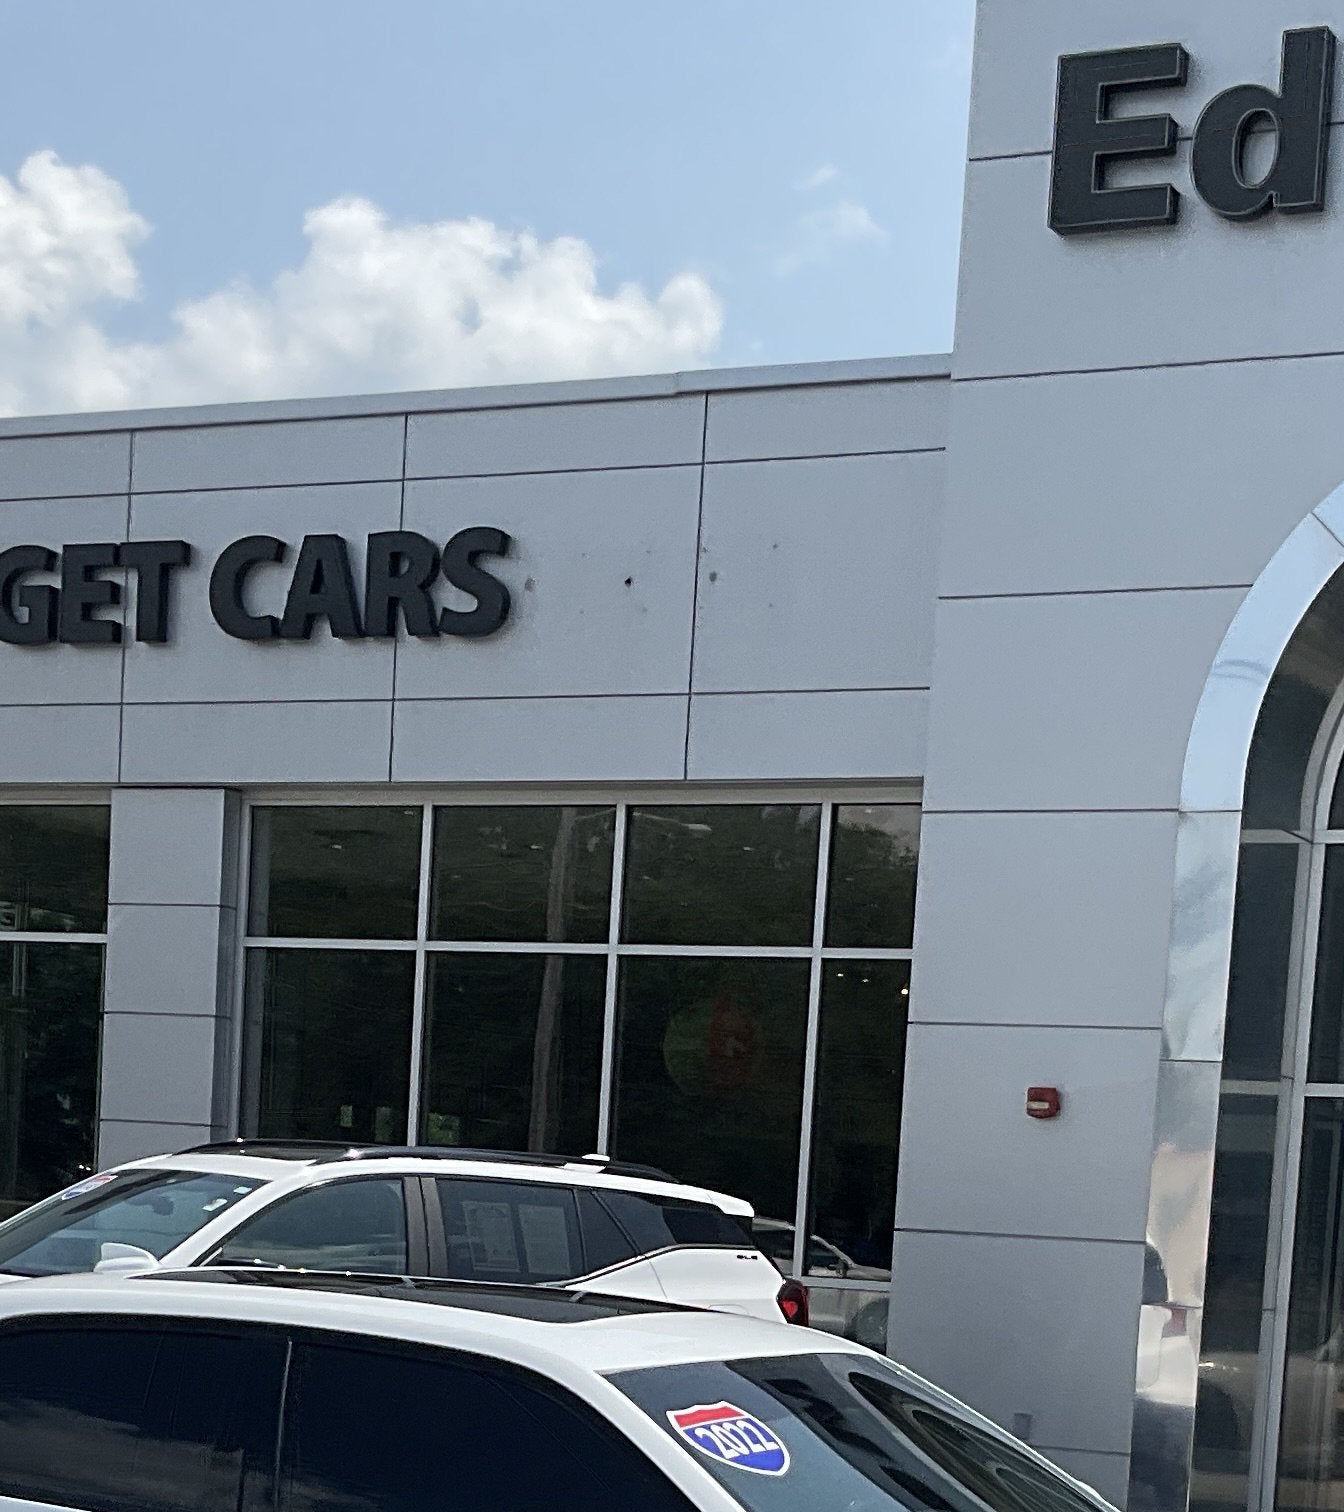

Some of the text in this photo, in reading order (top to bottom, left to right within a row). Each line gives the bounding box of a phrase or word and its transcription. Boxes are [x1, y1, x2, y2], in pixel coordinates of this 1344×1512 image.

[1048, 26, 1338, 237] Ed
[208, 526, 512, 642] CARS
[694, 1420, 780, 1460] 2022
